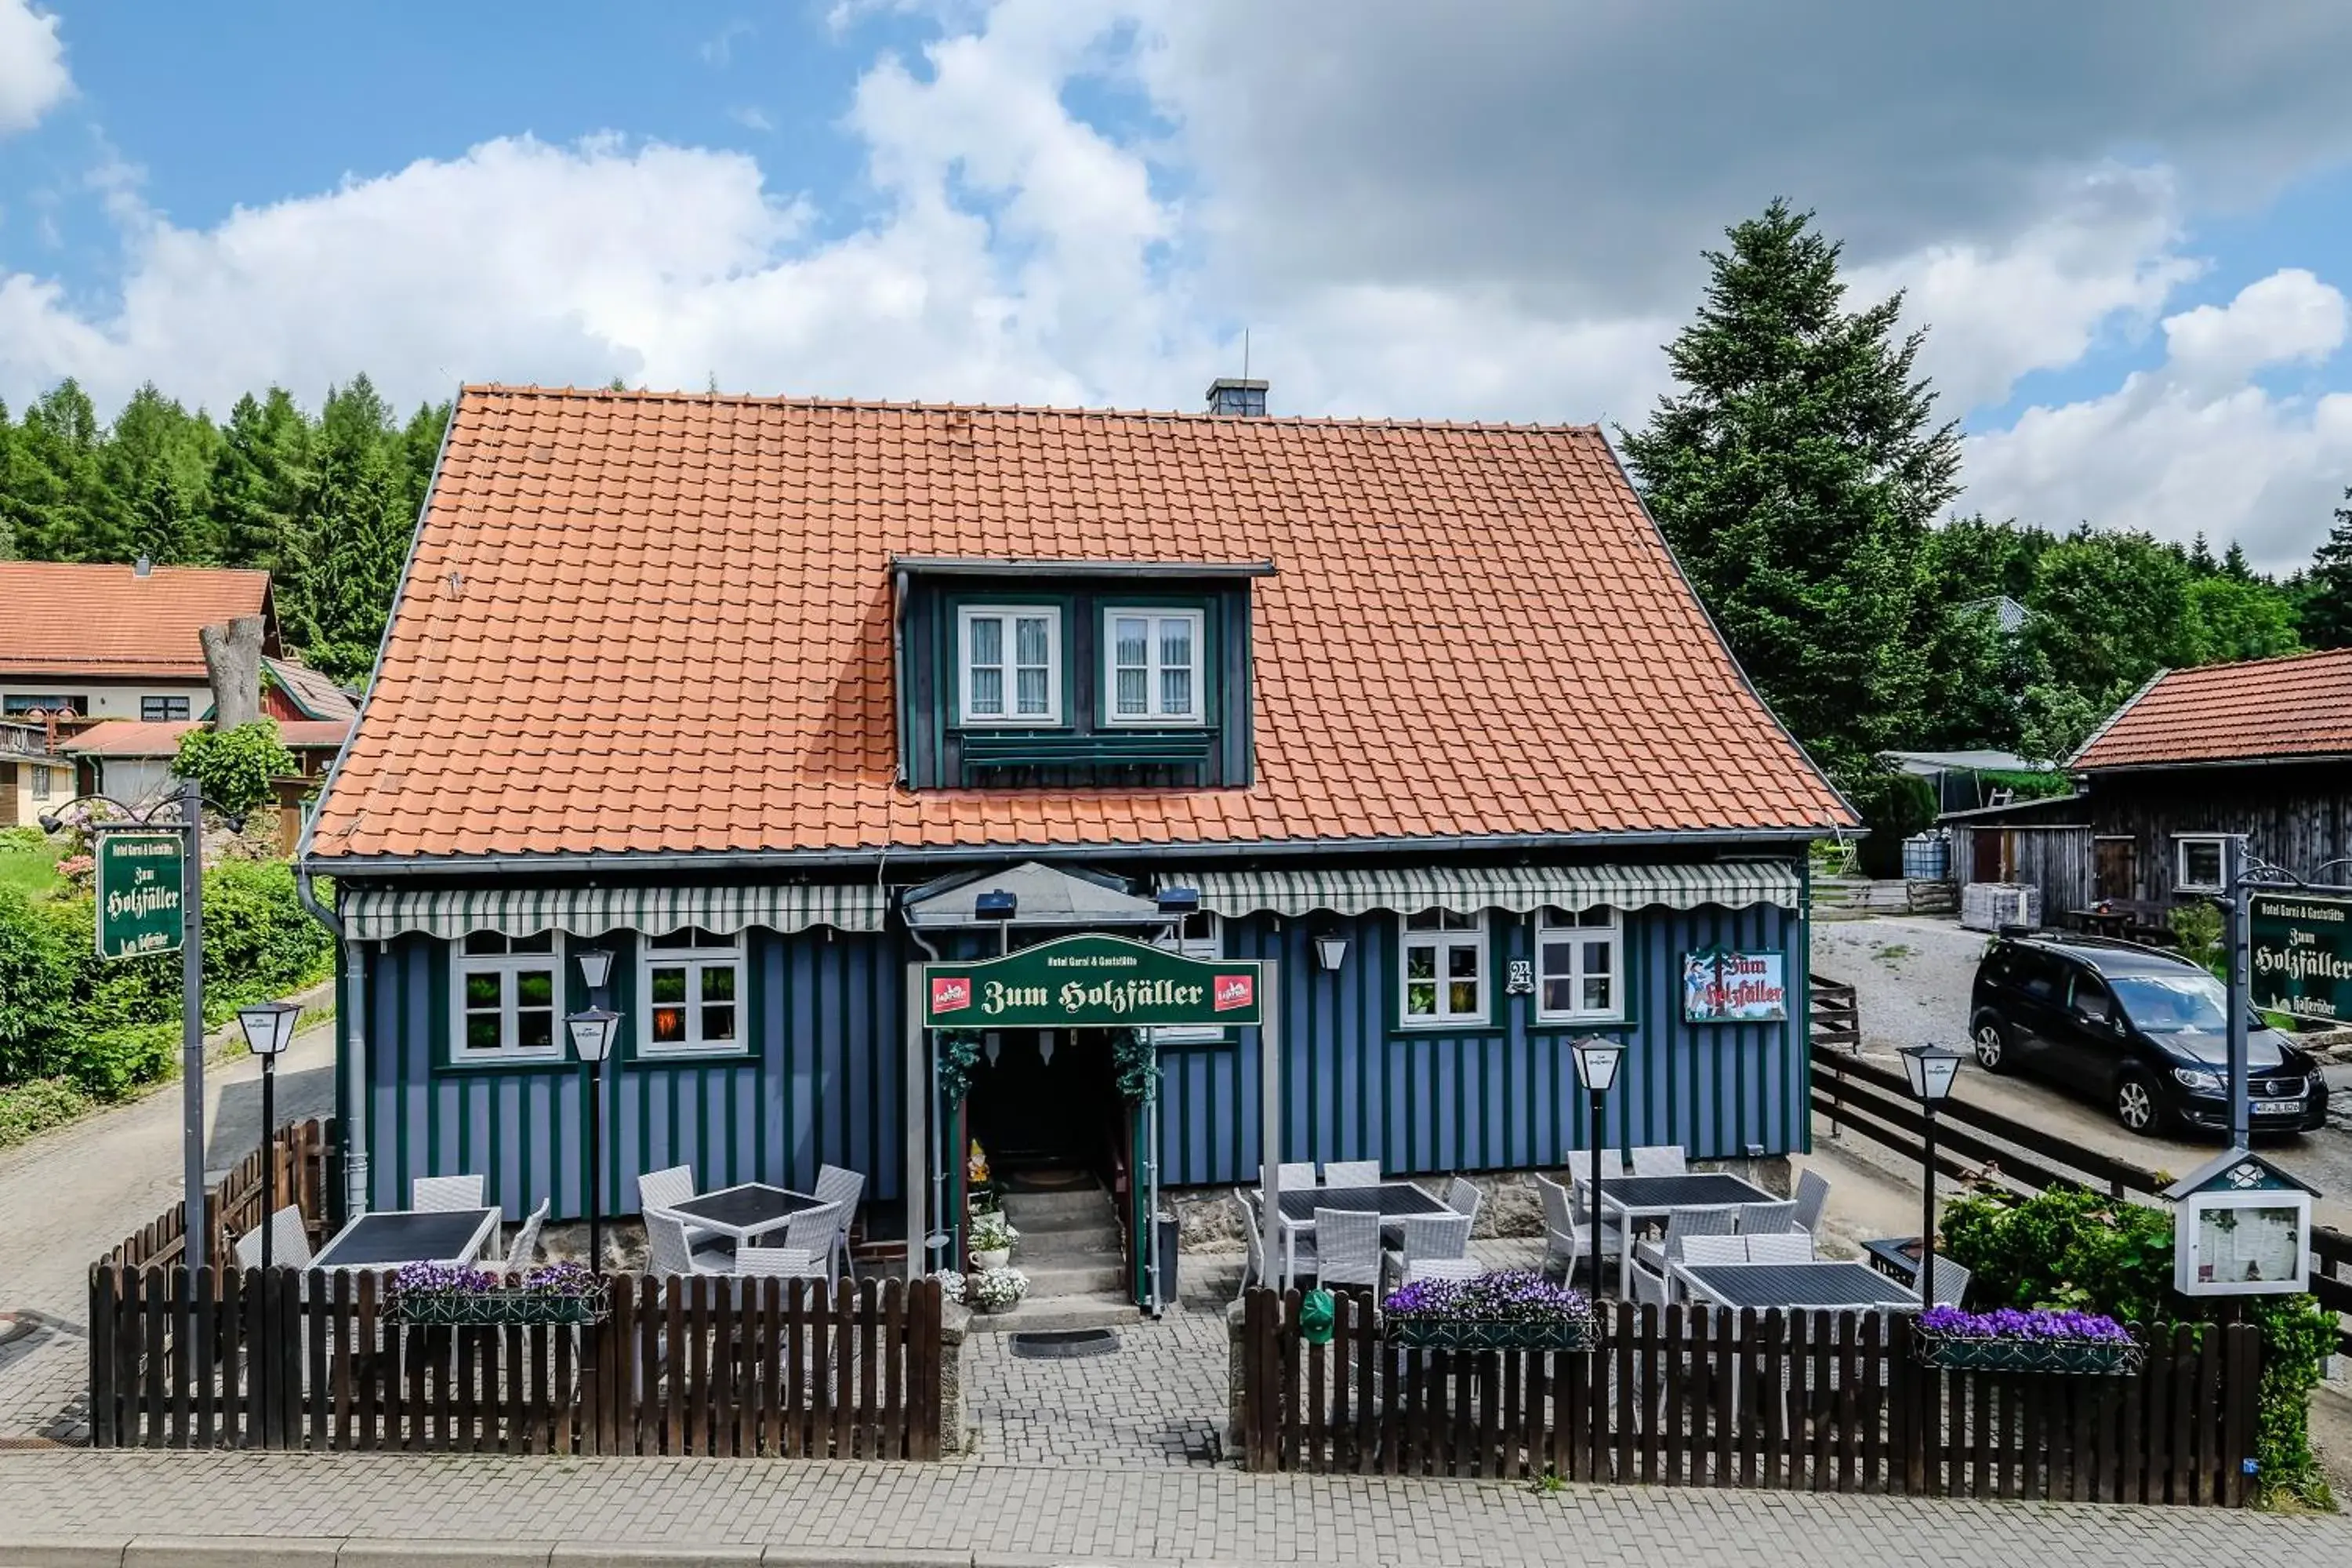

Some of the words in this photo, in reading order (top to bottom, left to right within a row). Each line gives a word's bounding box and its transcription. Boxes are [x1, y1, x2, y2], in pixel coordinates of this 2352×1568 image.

[134, 866, 154, 885] Zum
[107, 886, 180, 922] Holzfäller
[2288, 927, 2315, 946] Zum
[1511, 963, 1530, 982] 24
[1724, 952, 1767, 976] Zum
[2255, 945, 2352, 979] Holzfäller
[982, 981, 1049, 1014] Zum
[1058, 979, 1203, 1014] Holzfäller
